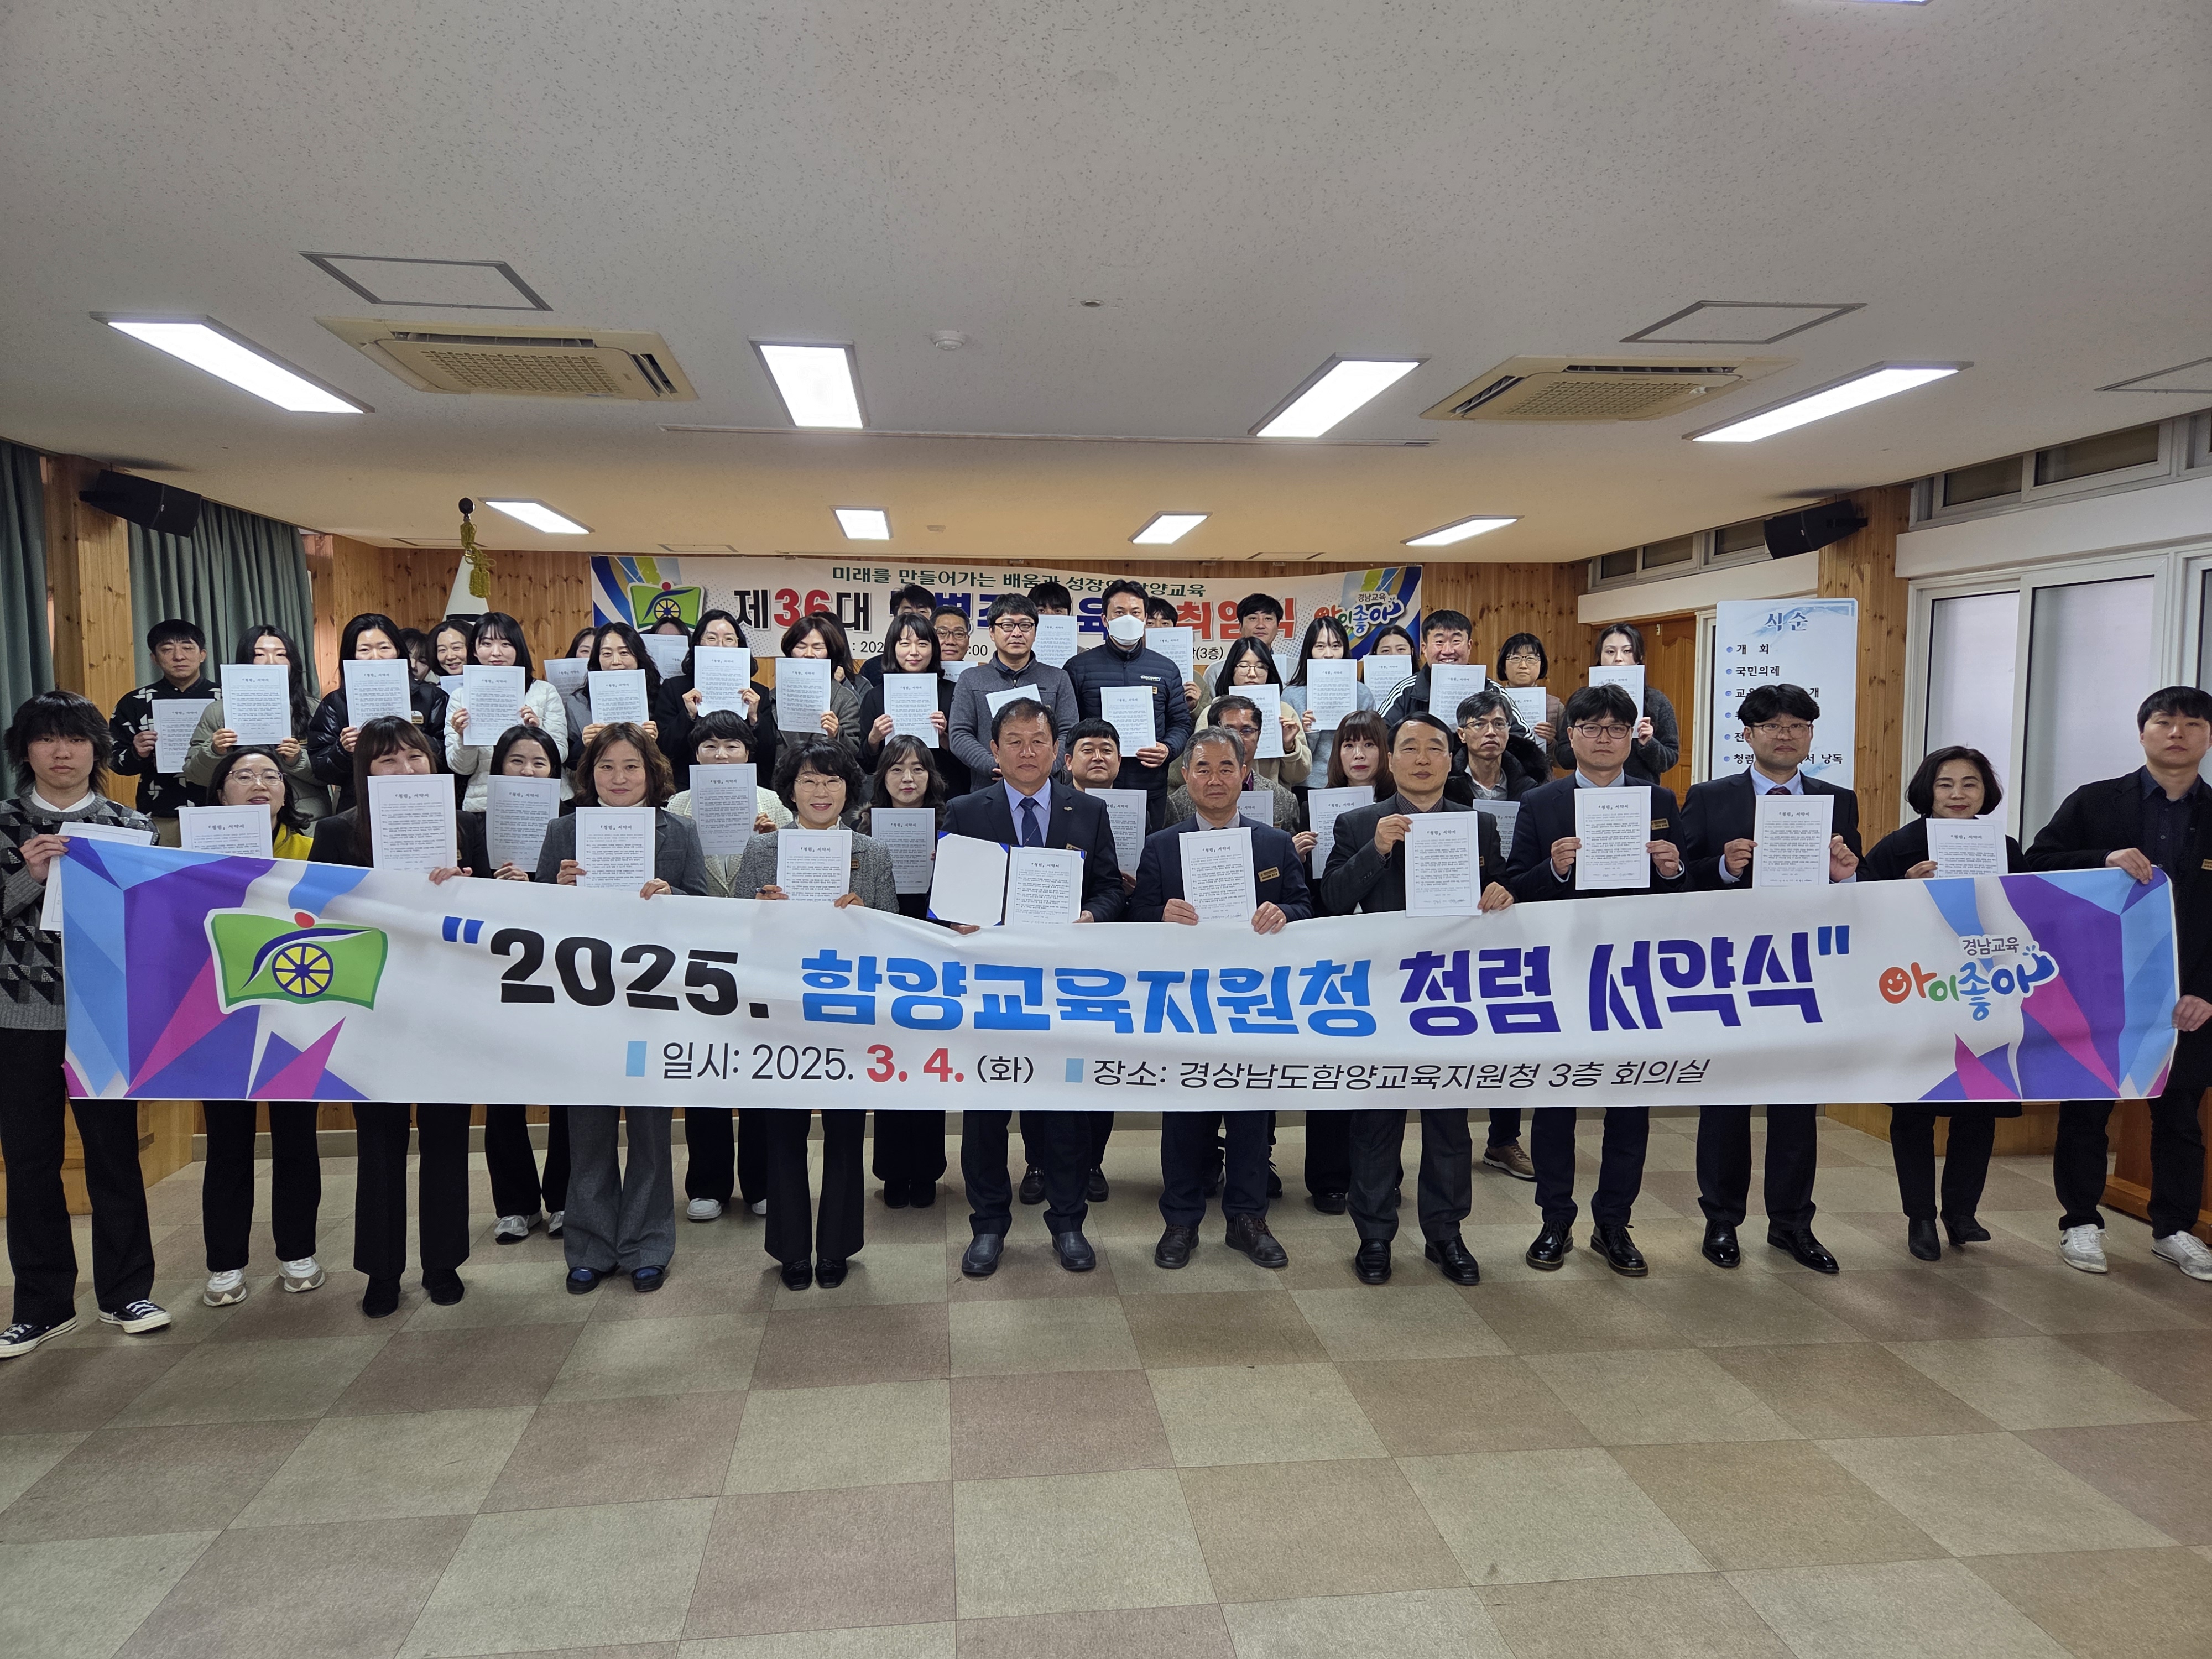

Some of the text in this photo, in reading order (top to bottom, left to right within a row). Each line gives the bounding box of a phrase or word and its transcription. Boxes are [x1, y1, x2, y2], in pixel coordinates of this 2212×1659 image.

[833, 567, 891, 583] 미래를
[899, 570, 996, 587] 만들어가는
[1358, 593, 1386, 602] 경남교육
[1735, 666, 1780, 677] 국민의례
[1821, 753, 1843, 764] 낭독
[1962, 936, 2020, 956] 경남교육
[801, 948, 1377, 1037] 함양교육지원청
[1399, 946, 1562, 1037] 청렴
[1879, 953, 2055, 1021] 아이좋아
[663, 1042, 1034, 1084] 일시: 2025. 3. 4. (화)
[1094, 1058, 1711, 1091] 장소: 경상남도함양교육지원청 3층 회의실
